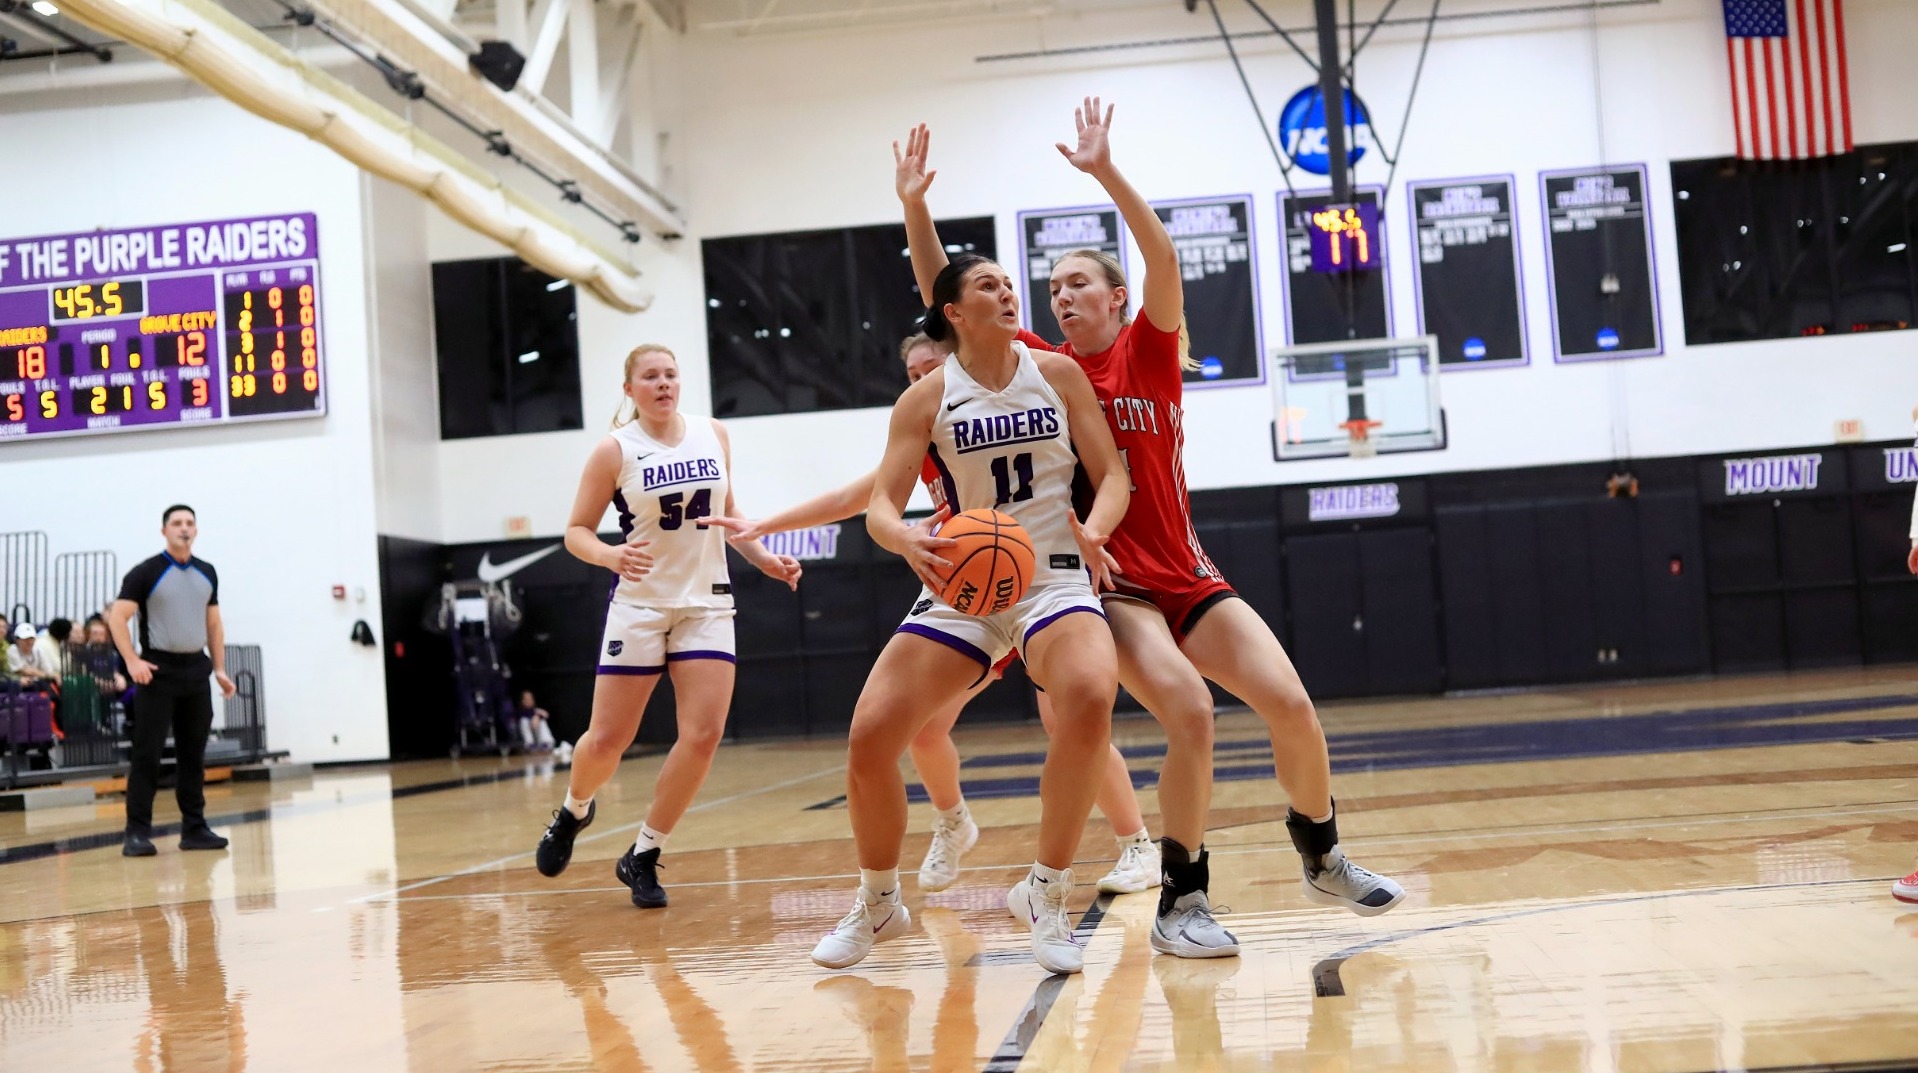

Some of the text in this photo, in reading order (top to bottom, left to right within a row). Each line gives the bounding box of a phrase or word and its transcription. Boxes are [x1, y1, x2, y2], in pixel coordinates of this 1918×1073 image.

[1286, 122, 1373, 156] NCA
[16, 239, 70, 280] THE
[75, 229, 181, 275] PURPLE
[186, 217, 306, 266] RAIDERS
[54, 281, 123, 320] 45.5
[17, 345, 46, 380] 18
[177, 331, 206, 367] 12
[0, 380, 26, 396] OULS
[6, 393, 24, 422] 5
[40, 390, 58, 419] 5
[90, 386, 107, 415] 2
[148, 381, 166, 410] 5
[192, 377, 208, 407] 3
[953, 407, 1059, 449] RAIDERS
[1113, 396, 1159, 435] CITY
[643, 458, 719, 488] RAIDERS
[990, 452, 1034, 509] 11
[1725, 454, 1822, 494] MOUNT
[659, 488, 712, 531] 54
[1309, 483, 1399, 514] RAIDERS
